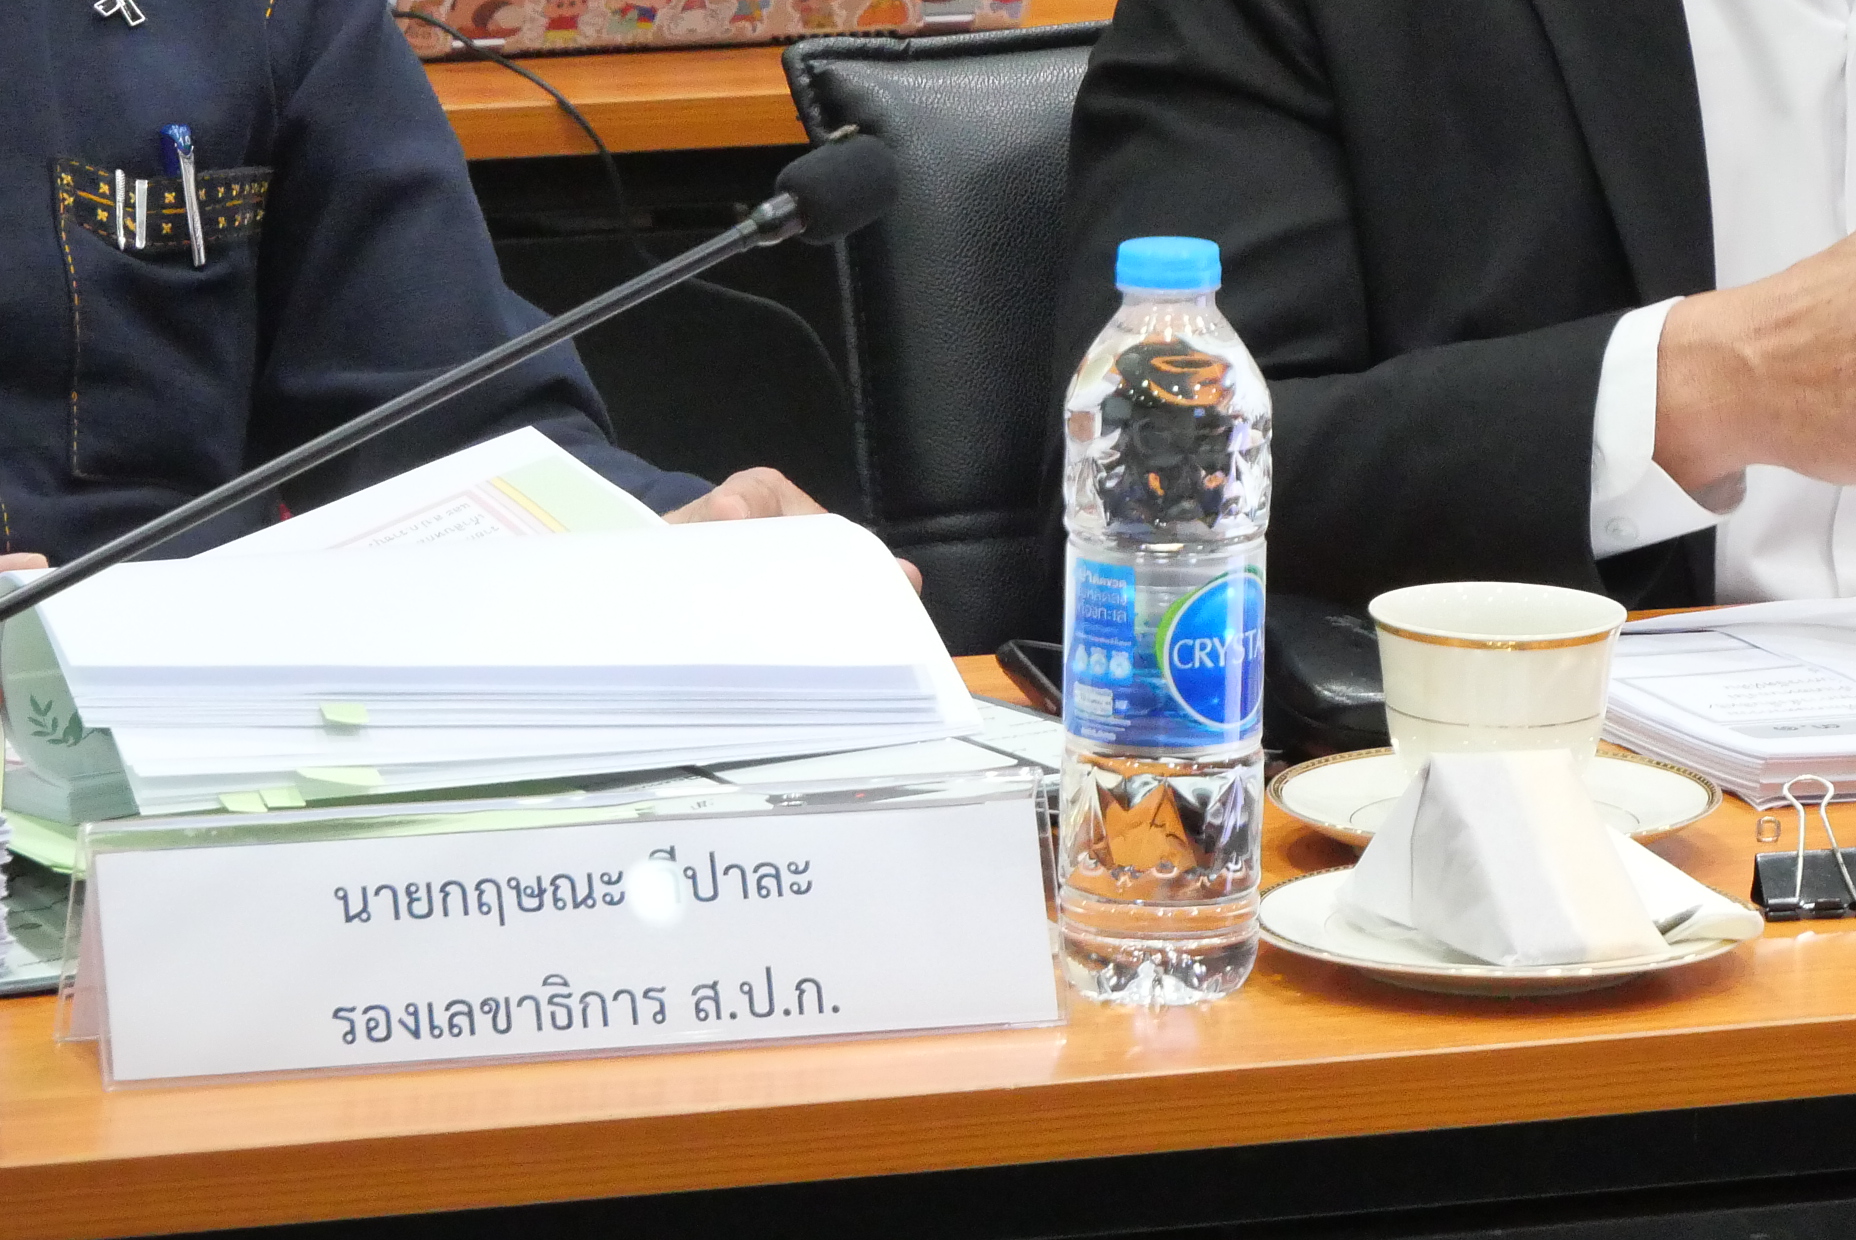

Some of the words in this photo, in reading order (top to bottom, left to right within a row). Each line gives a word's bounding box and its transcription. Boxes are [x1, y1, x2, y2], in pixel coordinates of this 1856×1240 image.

[333, 870, 626, 928] นายกฤษณะ
[646, 845, 813, 903] ีปาละ
[331, 973, 668, 1047] รองเลขาธิการ
[691, 966, 841, 1024] ส.ป.ก.
